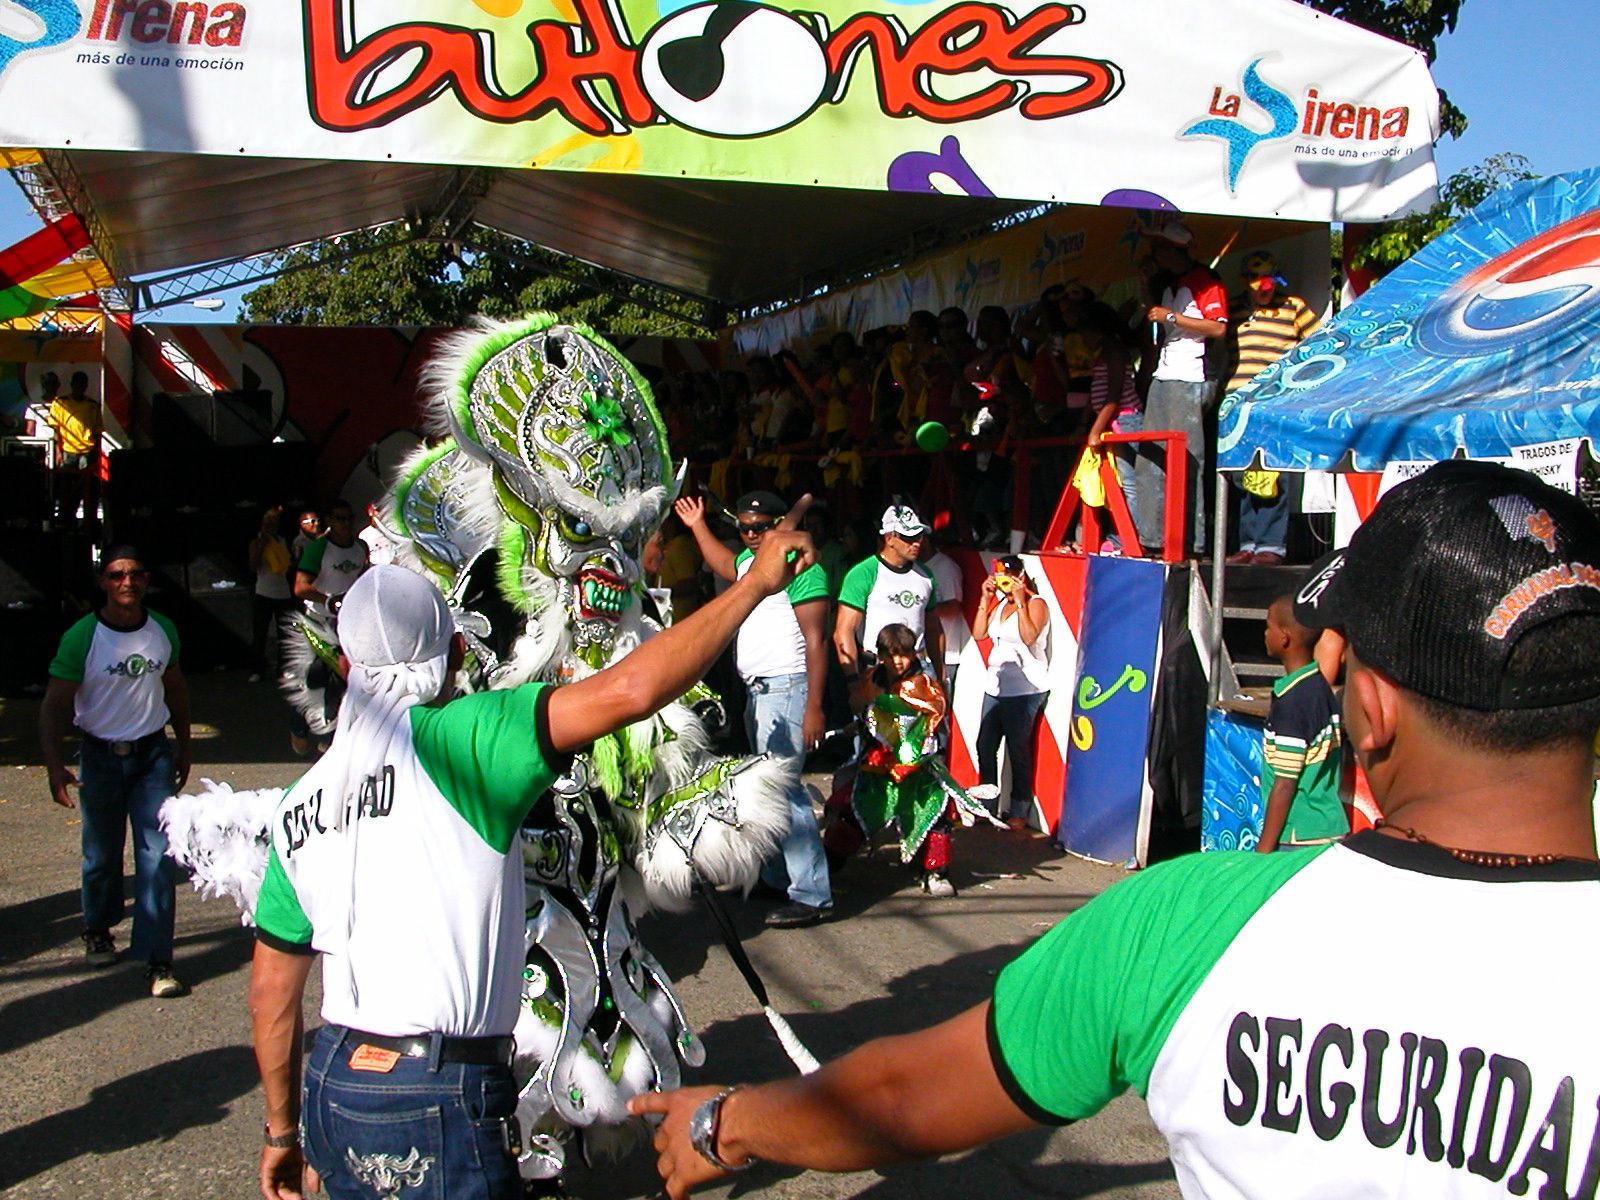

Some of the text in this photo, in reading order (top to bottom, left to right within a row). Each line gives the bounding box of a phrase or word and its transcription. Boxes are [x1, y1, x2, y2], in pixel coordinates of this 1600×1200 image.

[76, 52, 244, 71] más de una emoción
[1208, 86, 1242, 118] La
[1294, 143, 1317, 155] más
[1321, 146, 1335, 156] de
[1338, 148, 1358, 158] una
[1520, 444, 1557, 460] TRAGOS
[1223, 1011, 1600, 1200] SEGURIDA
